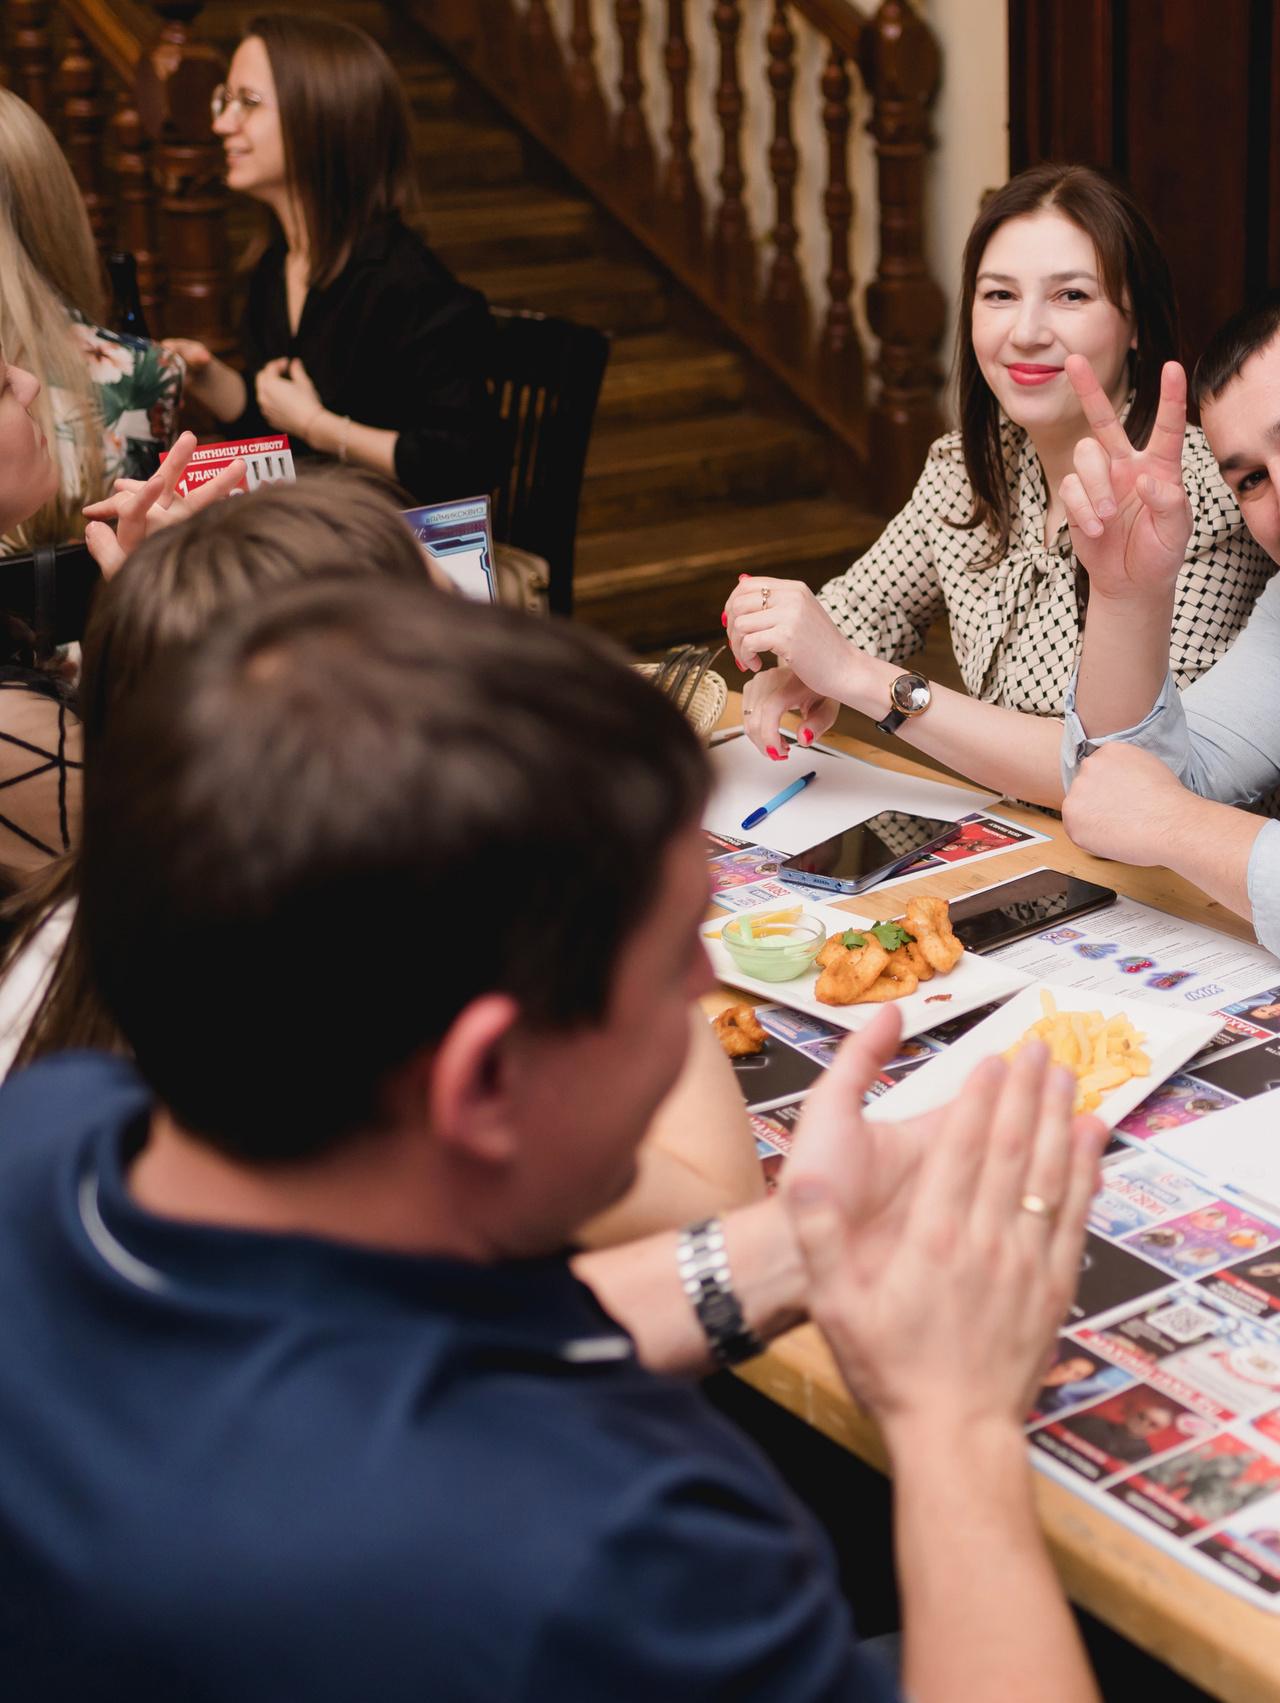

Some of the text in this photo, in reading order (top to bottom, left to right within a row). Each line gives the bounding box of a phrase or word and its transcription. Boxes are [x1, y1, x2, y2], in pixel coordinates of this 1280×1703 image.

[192, 440, 283, 461] ПЯТНИЦУ И СУББОТУ
